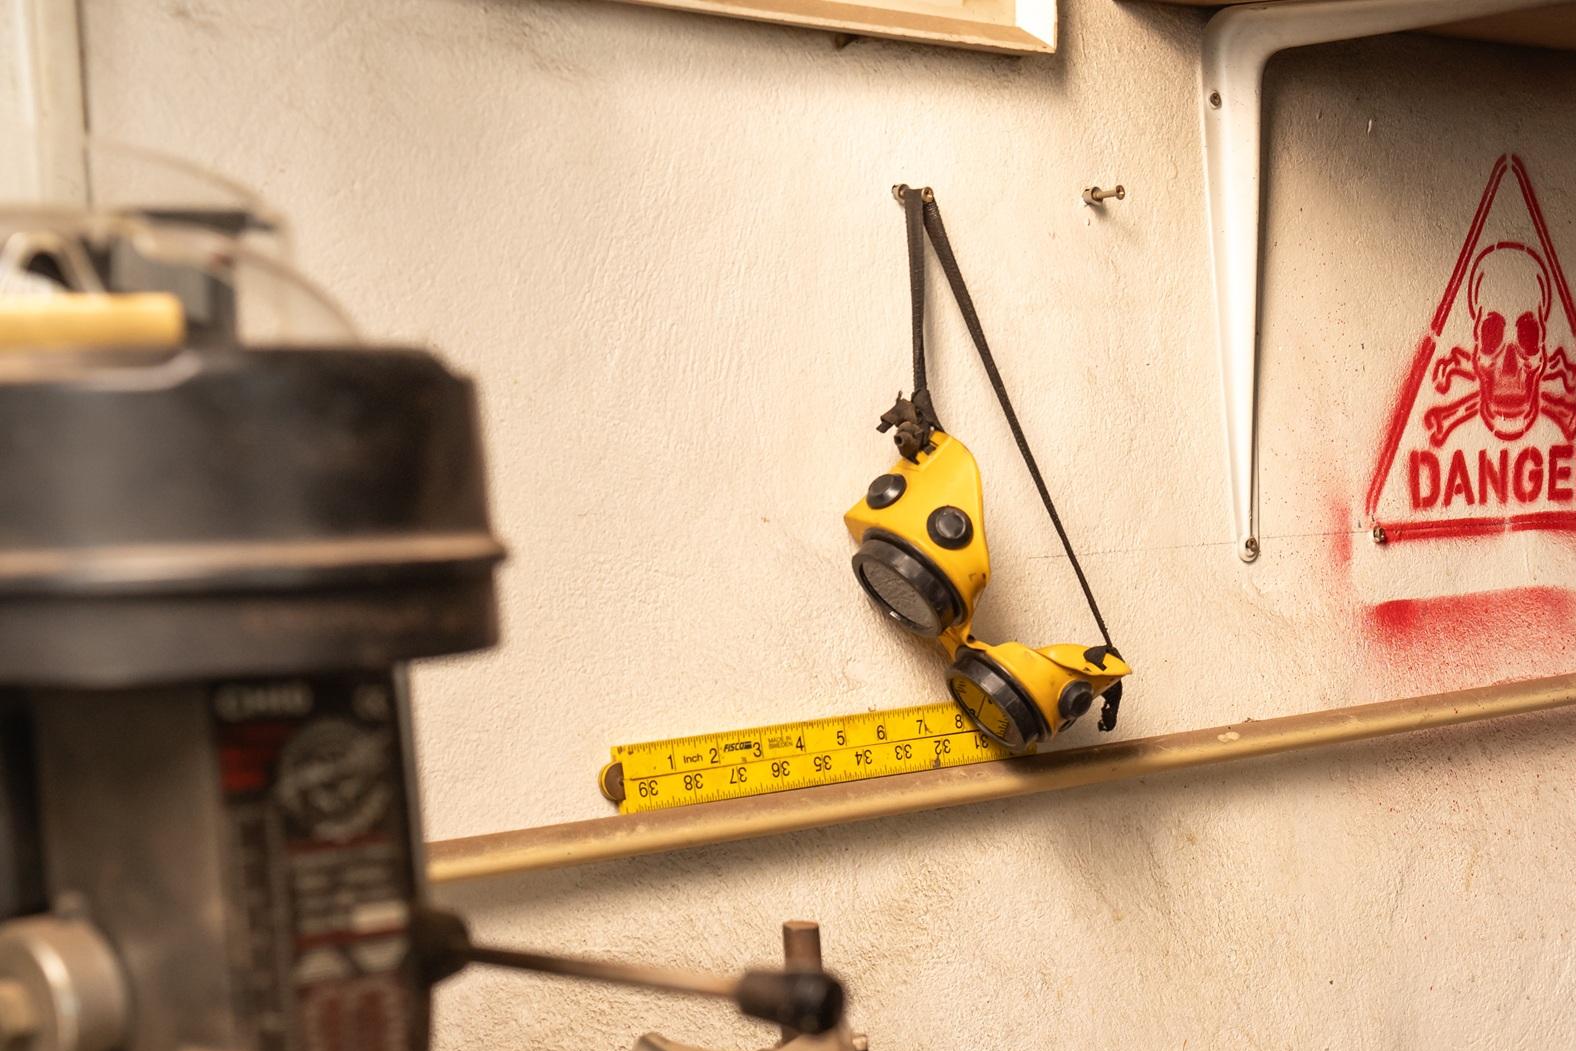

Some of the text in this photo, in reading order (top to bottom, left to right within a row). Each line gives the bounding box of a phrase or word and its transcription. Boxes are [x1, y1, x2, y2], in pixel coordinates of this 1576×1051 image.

[667, 713, 963, 770] 1 Inch 2 FISCO 3 4 5 6 7 8
[933, 738, 951, 755] 32
[855, 749, 873, 766] 34
[895, 743, 913, 761] 33
[771, 760, 791, 778] 36
[813, 755, 832, 772] 35
[683, 773, 704, 791] 38
[729, 766, 748, 785] 37
[638, 779, 659, 798] 39
